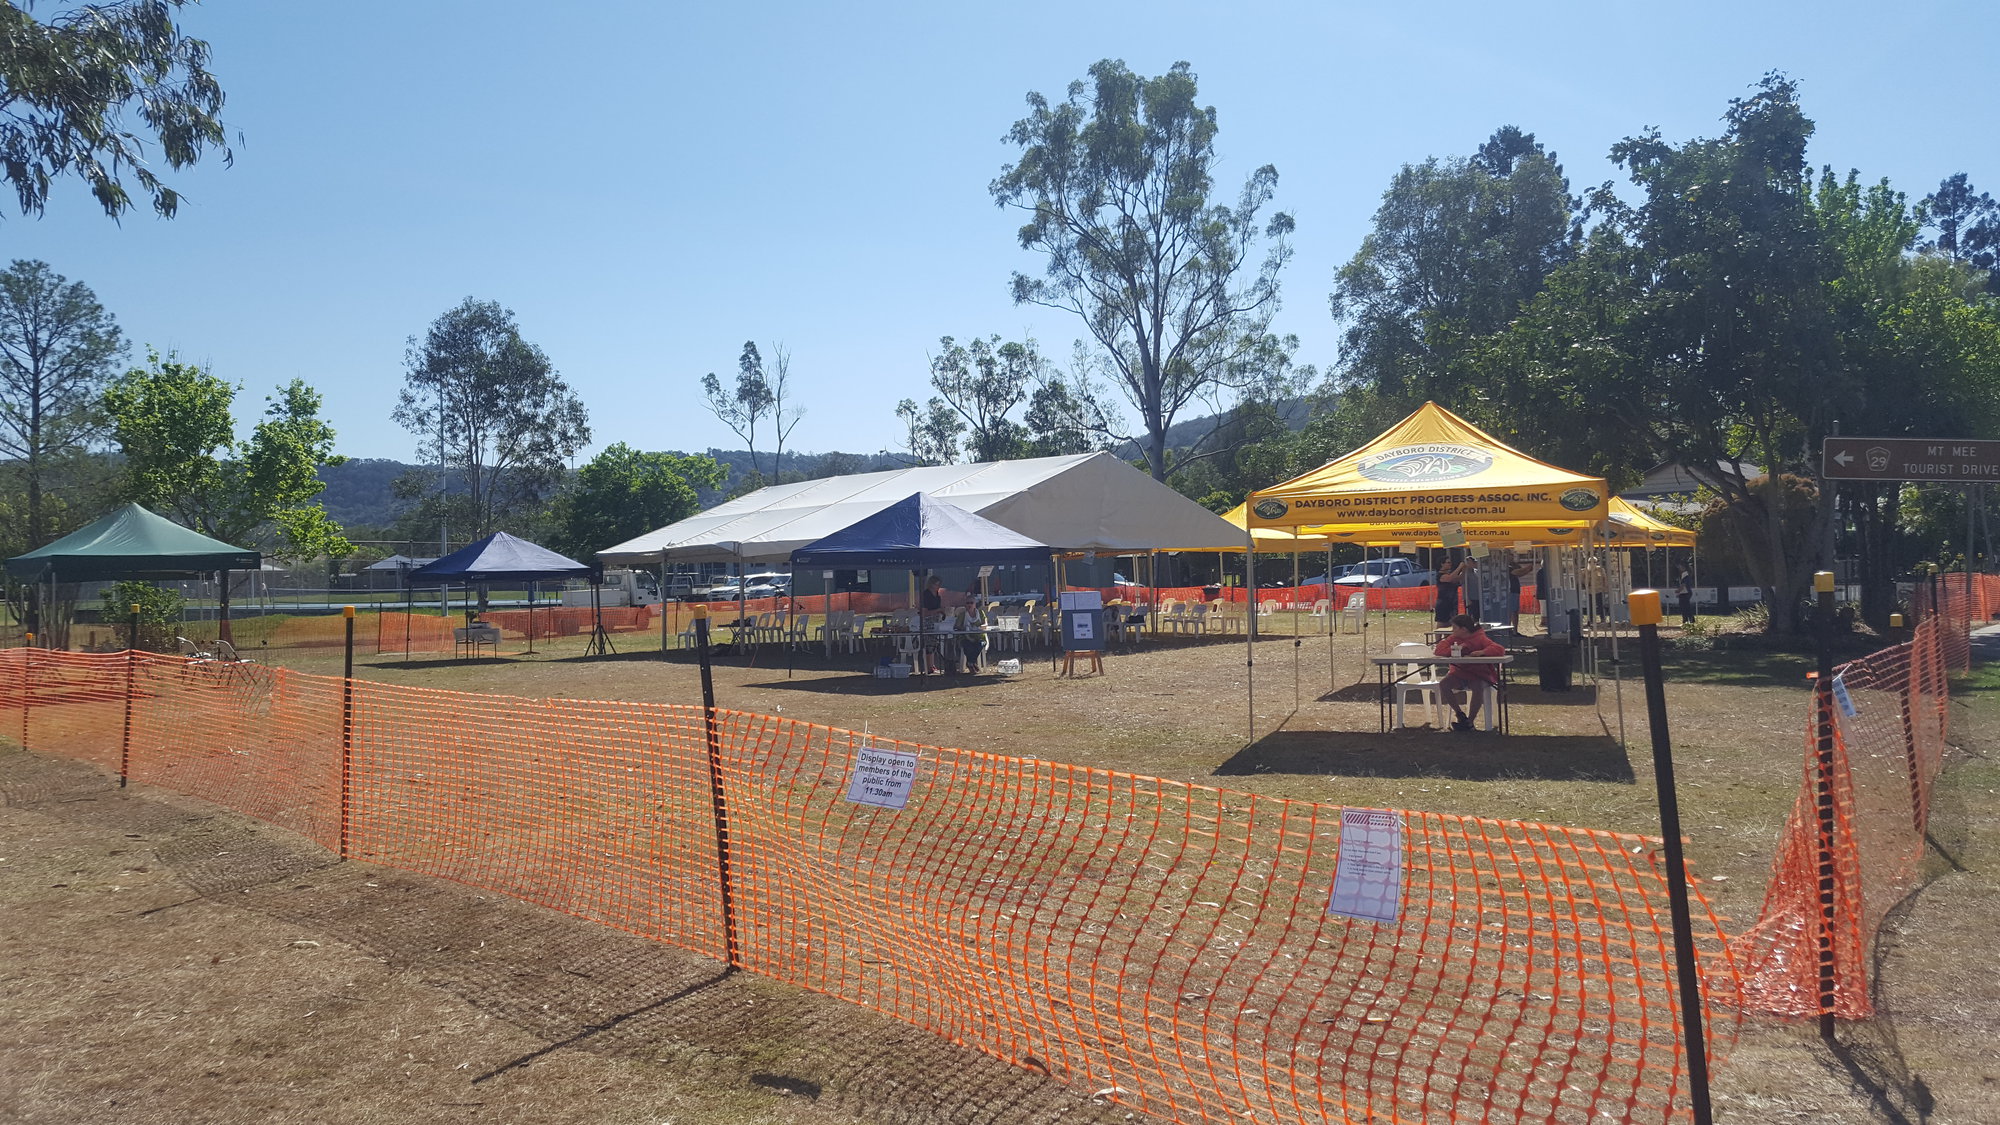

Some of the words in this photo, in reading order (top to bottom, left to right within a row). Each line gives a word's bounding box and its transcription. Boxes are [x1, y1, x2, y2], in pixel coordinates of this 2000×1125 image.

[1376, 446, 1425, 461] DAYBORO
[1428, 446, 1474, 456] DISTRICT
[1928, 446, 1944, 456] MT
[1952, 446, 1977, 456] MEE
[1871, 456, 1887, 467] 29
[1903, 463, 1954, 474] TOURIST
[1962, 464, 1999, 475] DRIVE
[1295, 498, 1351, 509] DAYBORO
[1354, 496, 1407, 507] DISTRICT
[1410, 494, 1474, 504] PROGRESS
[1478, 493, 1524, 503] ASSOC.
[1527, 492, 1552, 502] INC.
[1337, 505, 1506, 518] www.dayborodistrict.com.au
[1391, 529, 1510, 537] www.dayborict.com.au
[861, 753, 887, 765] Display
[888, 759, 905, 767] open
[906, 759, 914, 768] to
[858, 765, 890, 776] members
[892, 769, 899, 777] of
[900, 770, 912, 779] the
[862, 776, 884, 786] public
[885, 779, 902, 788] from
[865, 786, 893, 797] 11.30am
